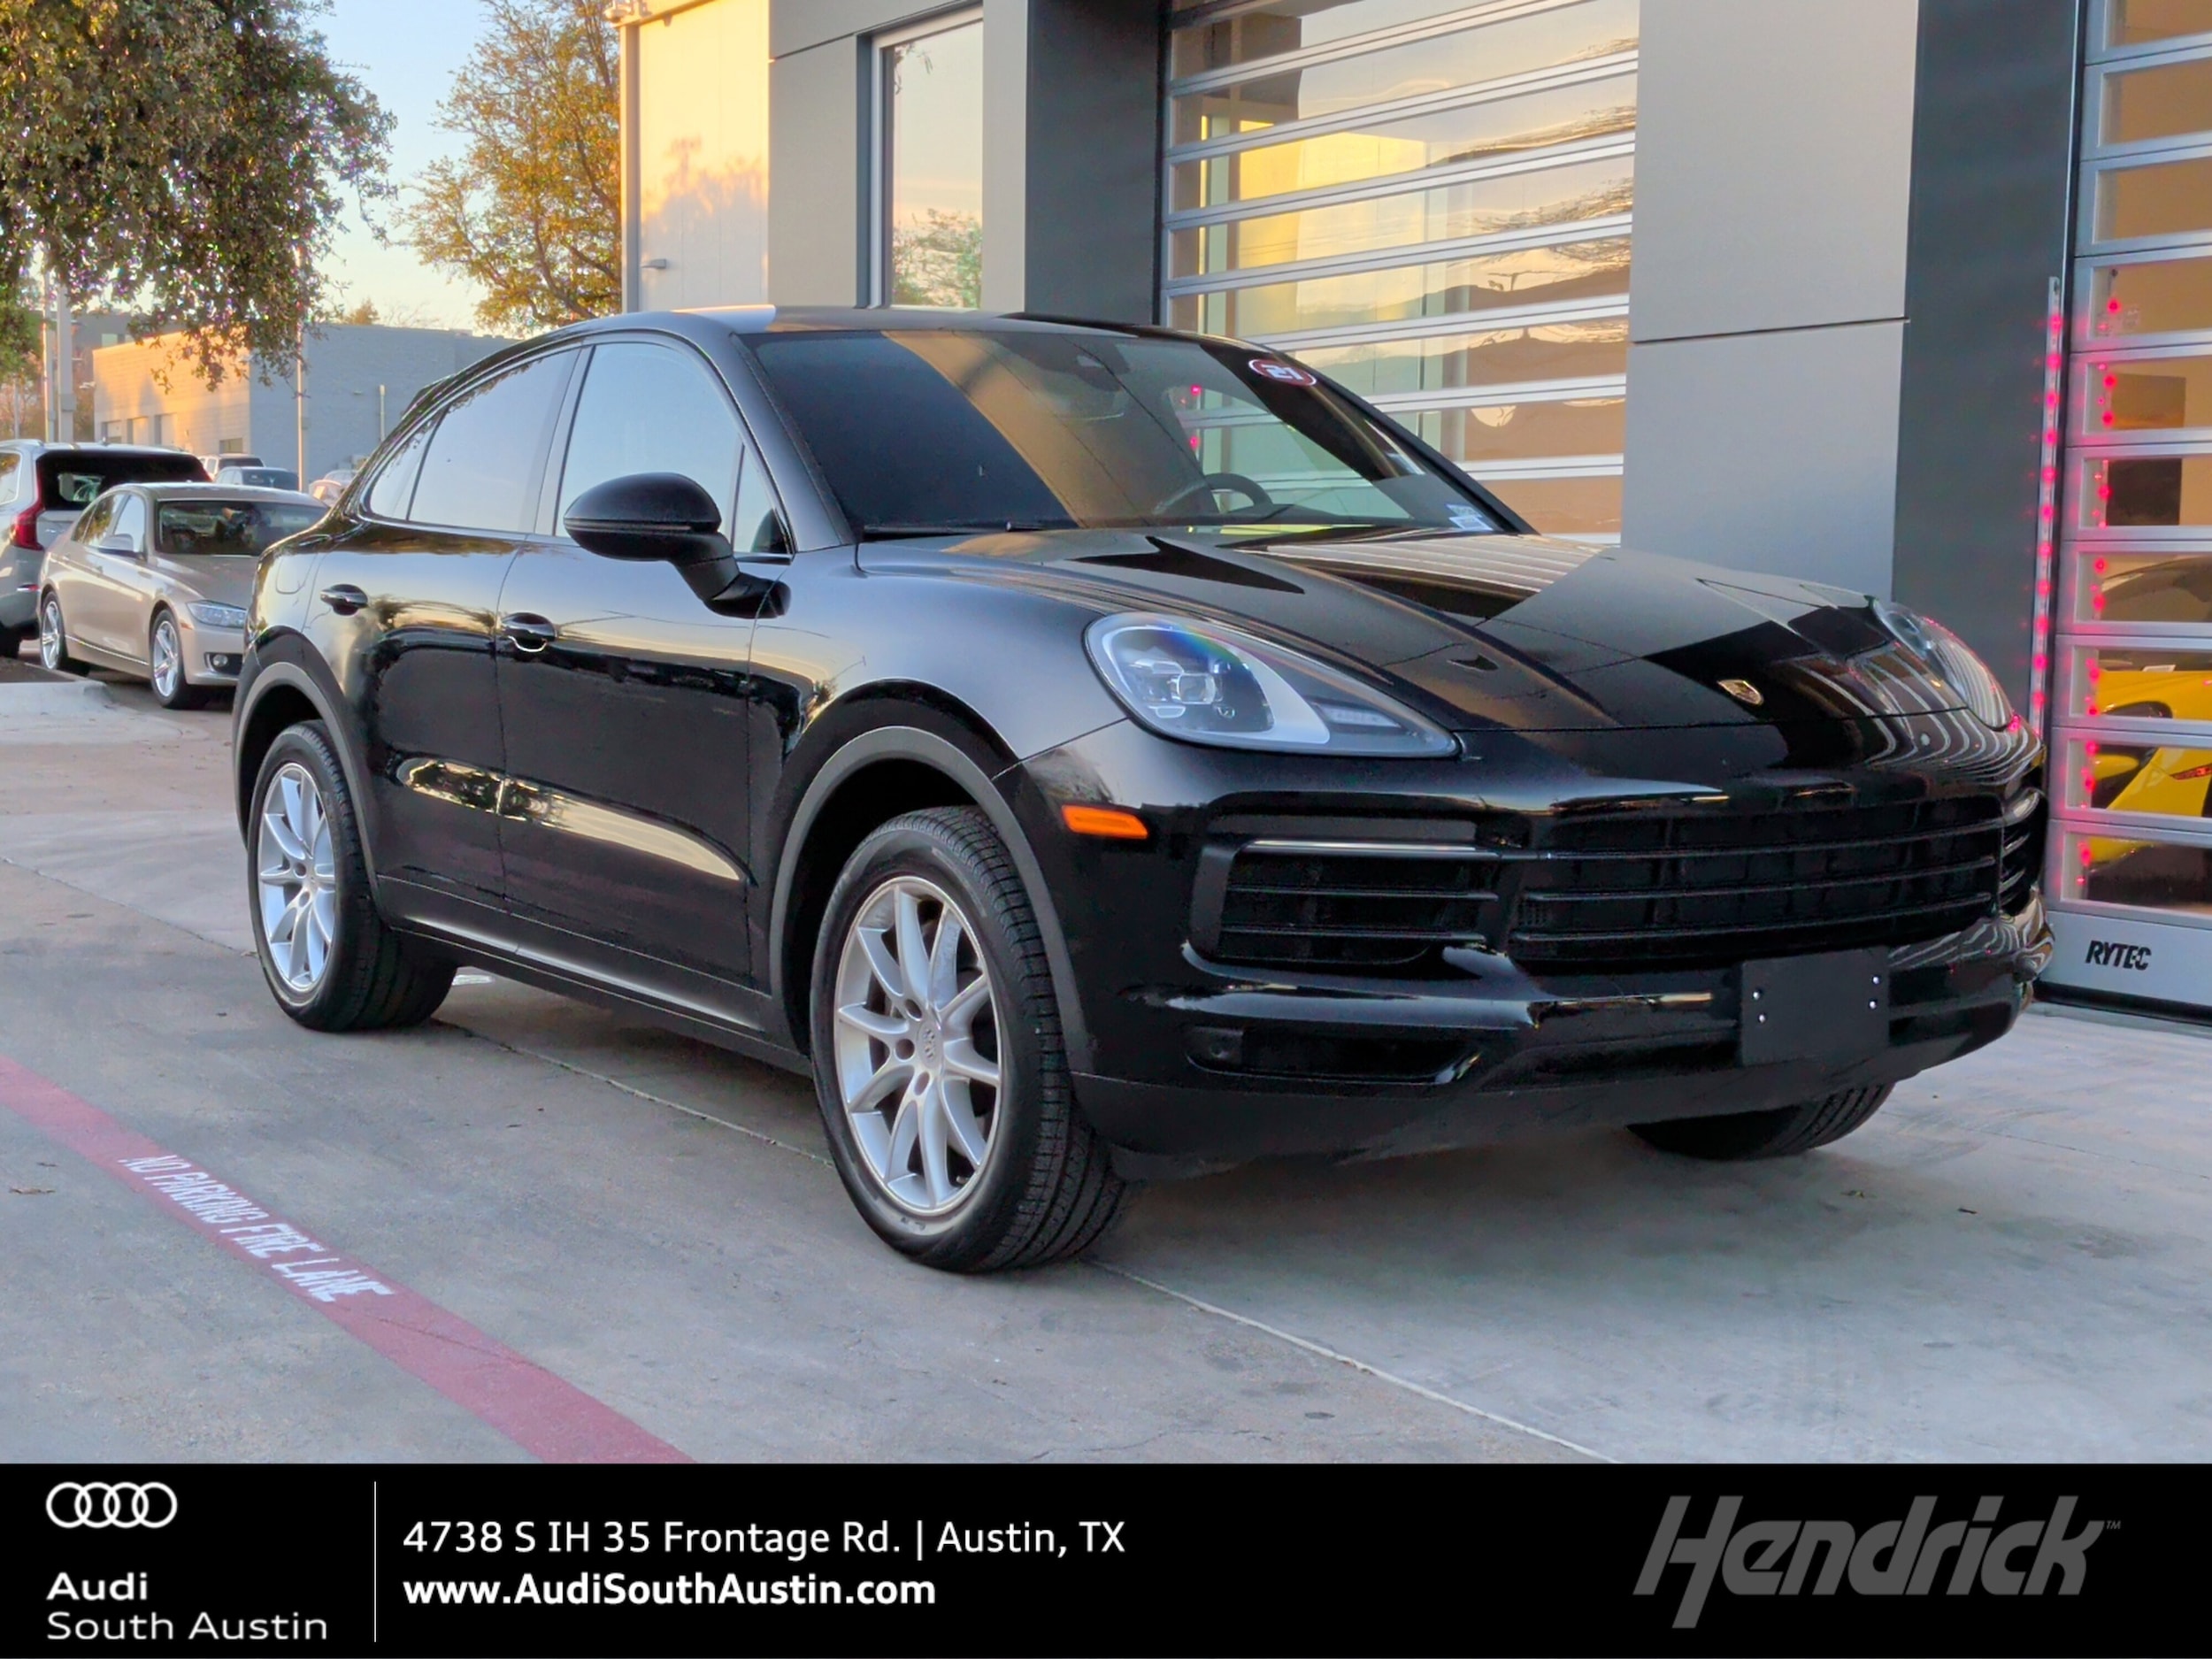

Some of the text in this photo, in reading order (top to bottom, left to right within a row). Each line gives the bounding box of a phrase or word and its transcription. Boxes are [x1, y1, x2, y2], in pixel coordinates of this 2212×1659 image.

[1261, 364, 1304, 380] 21
[2085, 940, 2152, 971] RYTEC
[117, 1155, 396, 1303] NO PARKING FIRE LANE
